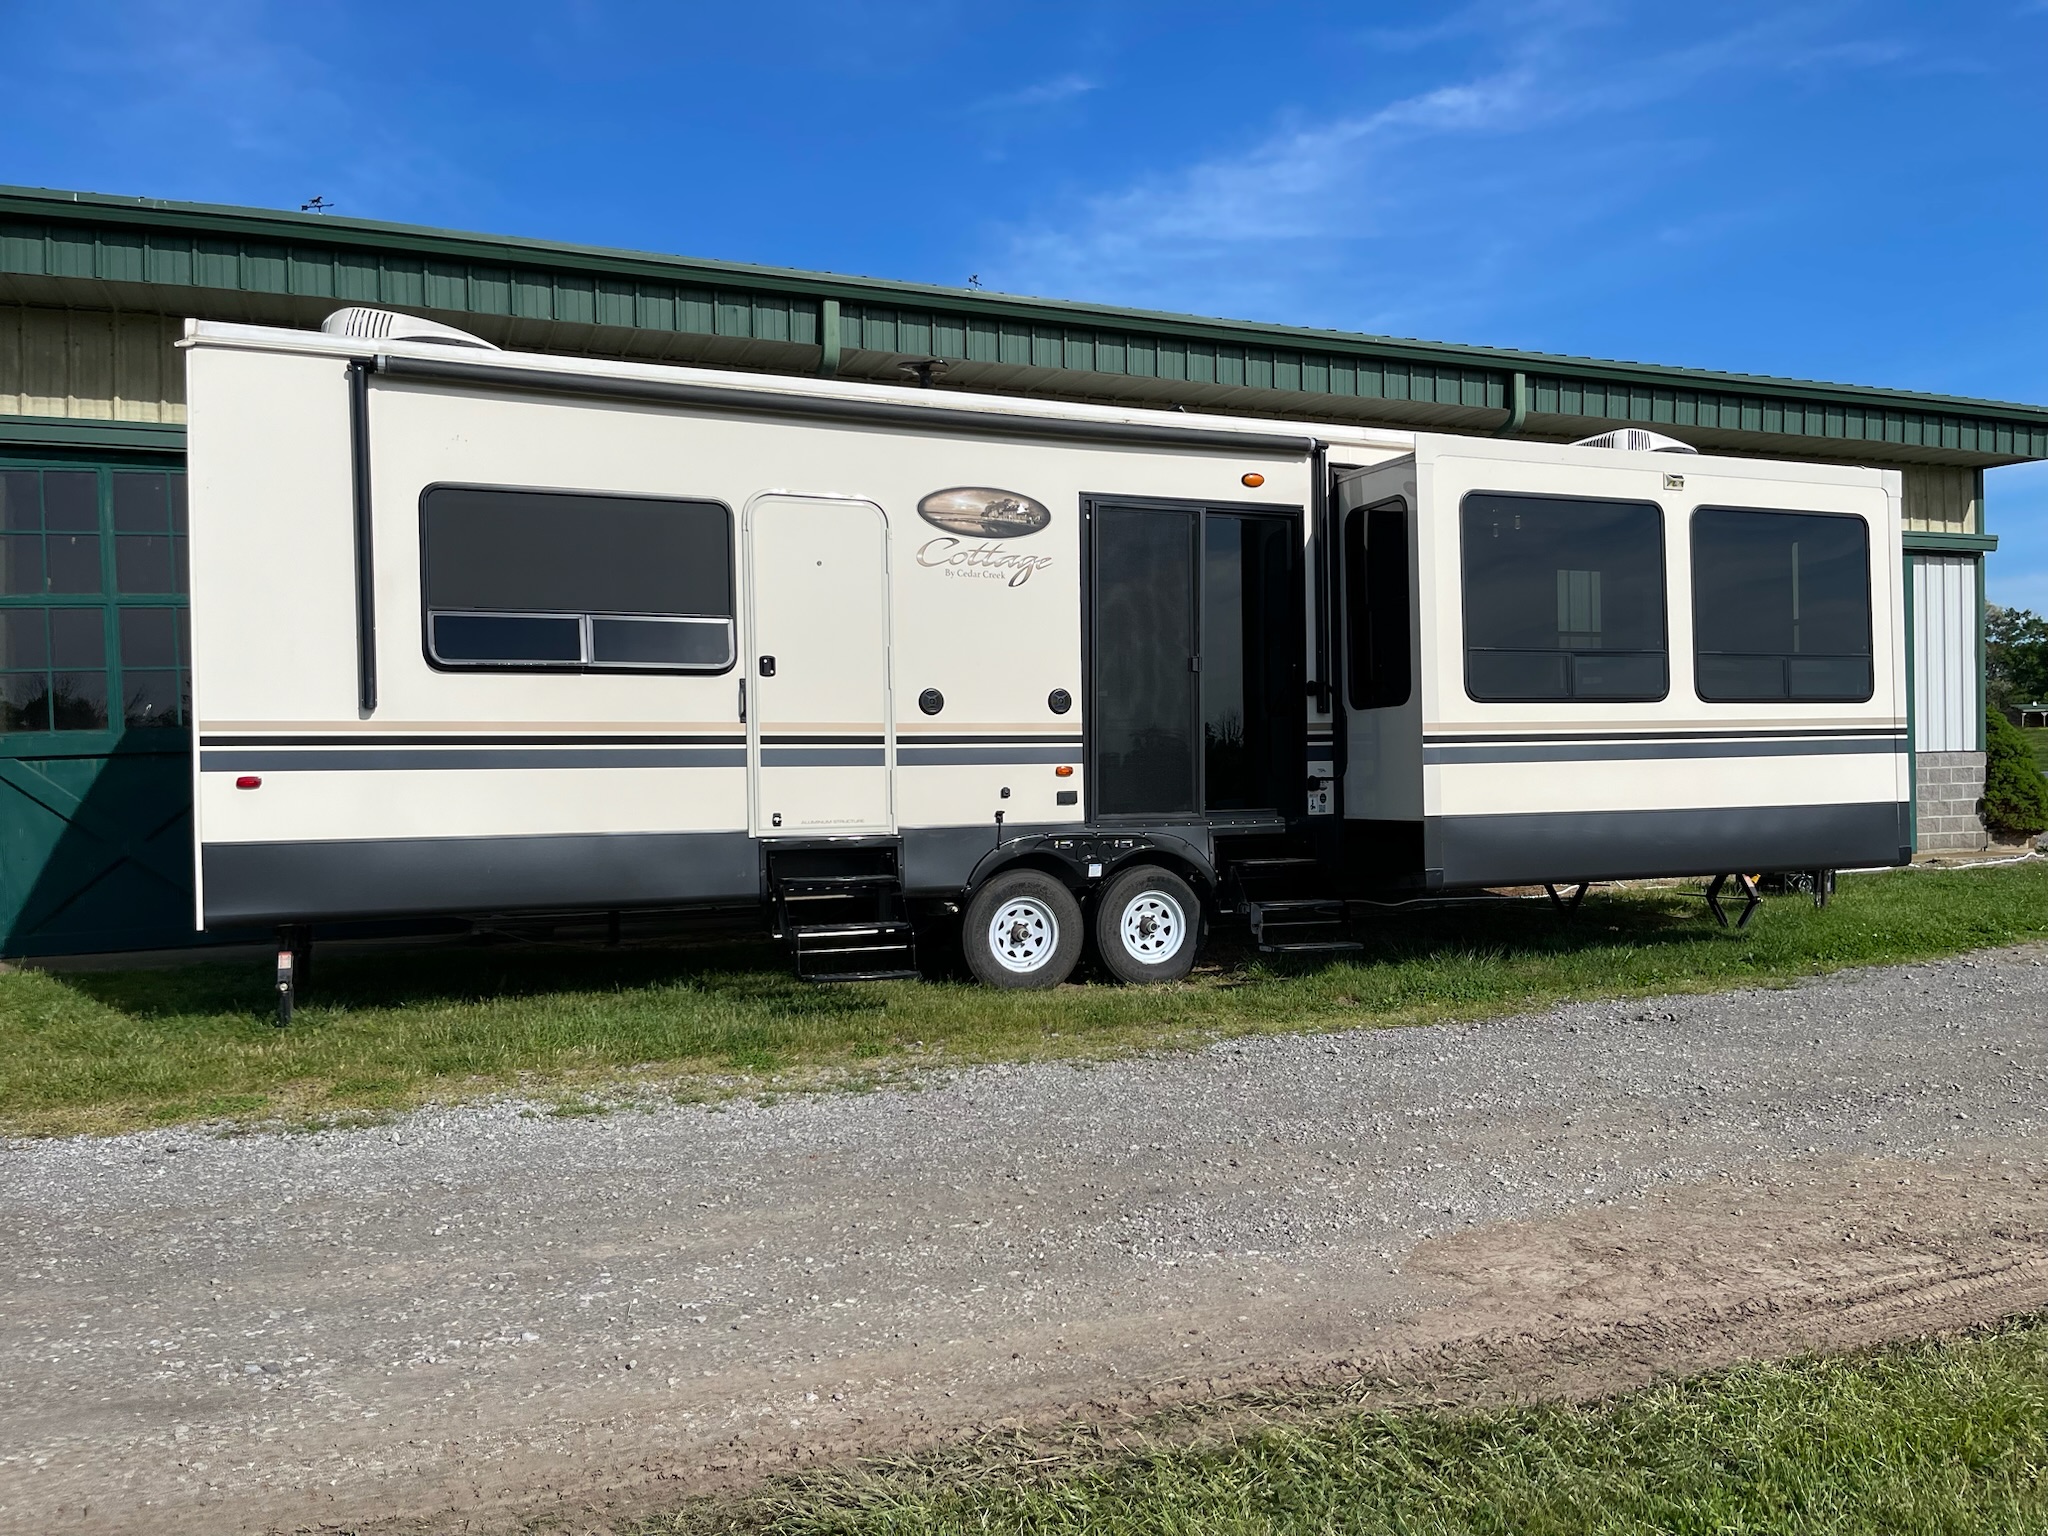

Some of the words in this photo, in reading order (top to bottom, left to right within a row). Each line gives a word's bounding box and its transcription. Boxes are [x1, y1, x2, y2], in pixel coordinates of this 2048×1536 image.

[916, 537, 1053, 588] Cottage
[945, 569, 955, 579] By
[956, 569, 980, 579] Cedar
[982, 570, 1006, 580] Creek
